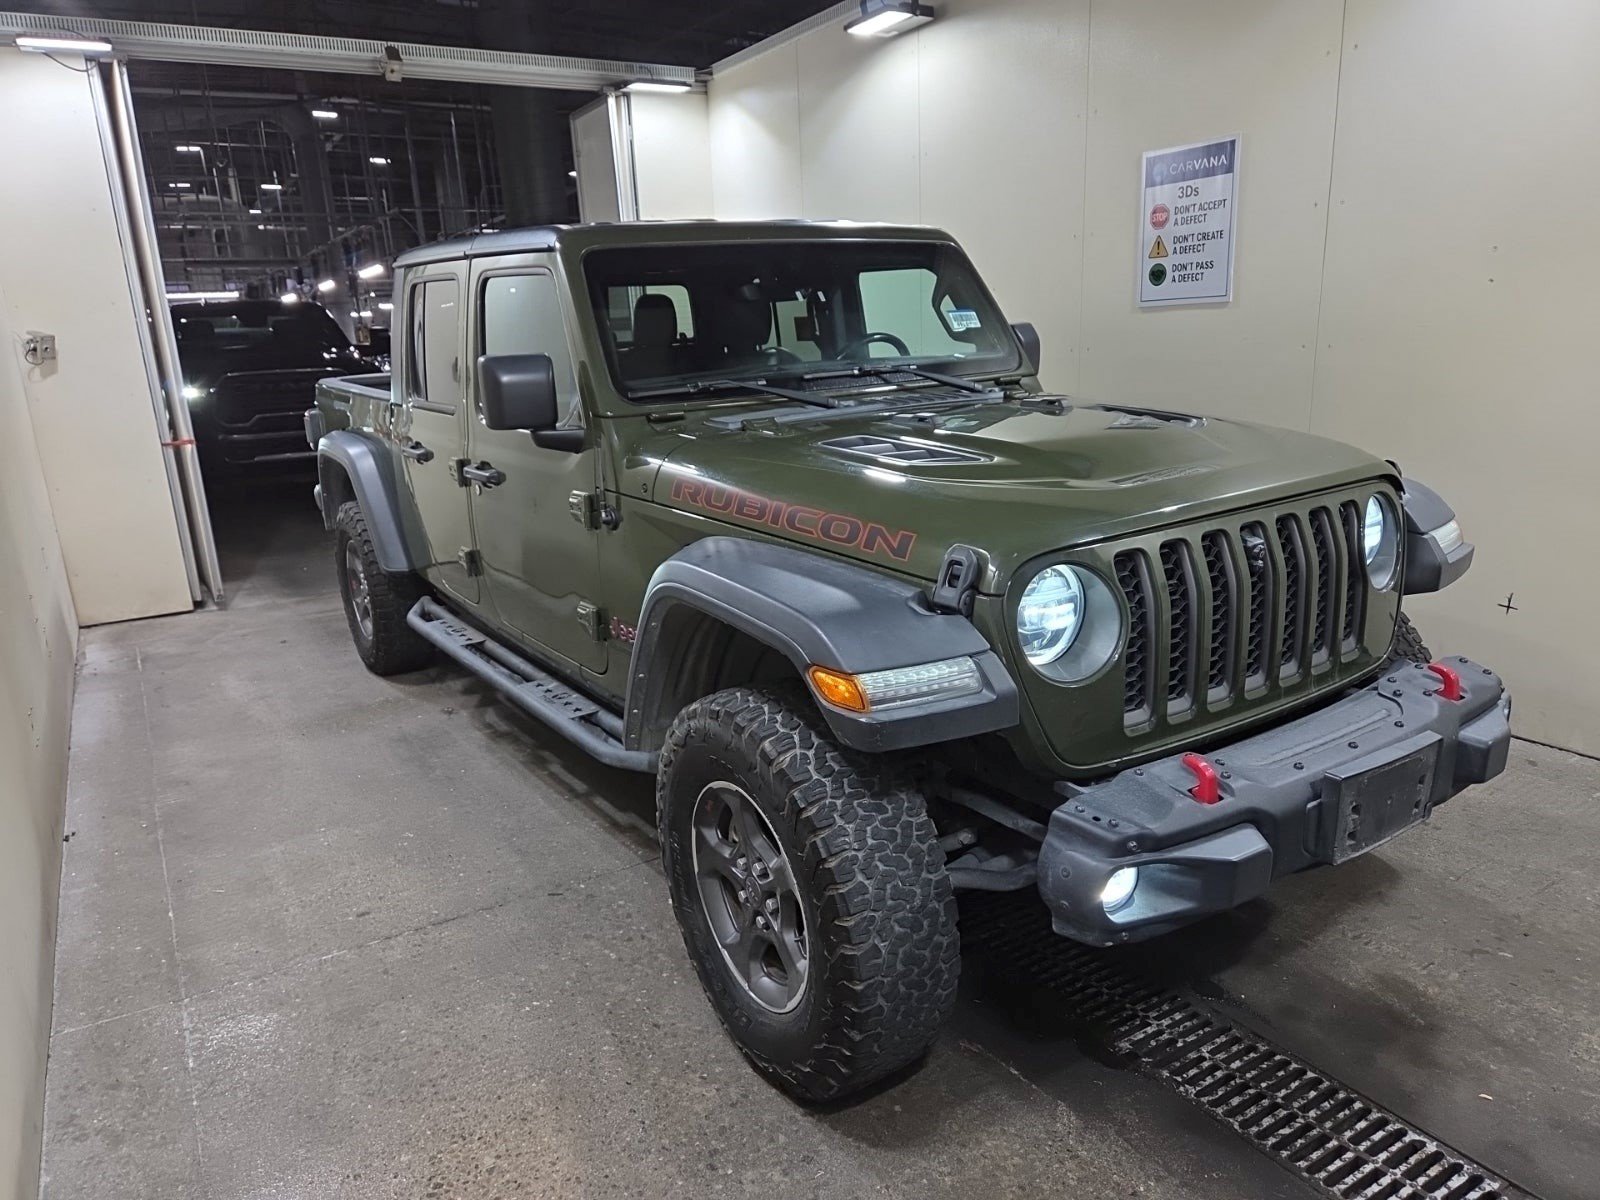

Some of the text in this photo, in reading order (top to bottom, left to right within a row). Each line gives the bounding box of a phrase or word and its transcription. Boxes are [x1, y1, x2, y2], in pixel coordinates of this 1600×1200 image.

[1170, 154, 1227, 174] CARVANA
[1178, 184, 1200, 199] 3Ds
[1174, 198, 1227, 216] DON'T ACCEPT
[1152, 213, 1168, 223] STOP
[1173, 213, 1207, 227] A DEFECT
[1173, 229, 1224, 245] DON'T CREATE
[1172, 243, 1206, 255] A DEFECT
[1172, 260, 1214, 273] DON'T PASS
[1171, 272, 1204, 283] A DEFECT
[671, 477, 917, 562] RUBICON
[609, 616, 638, 643] Jee
